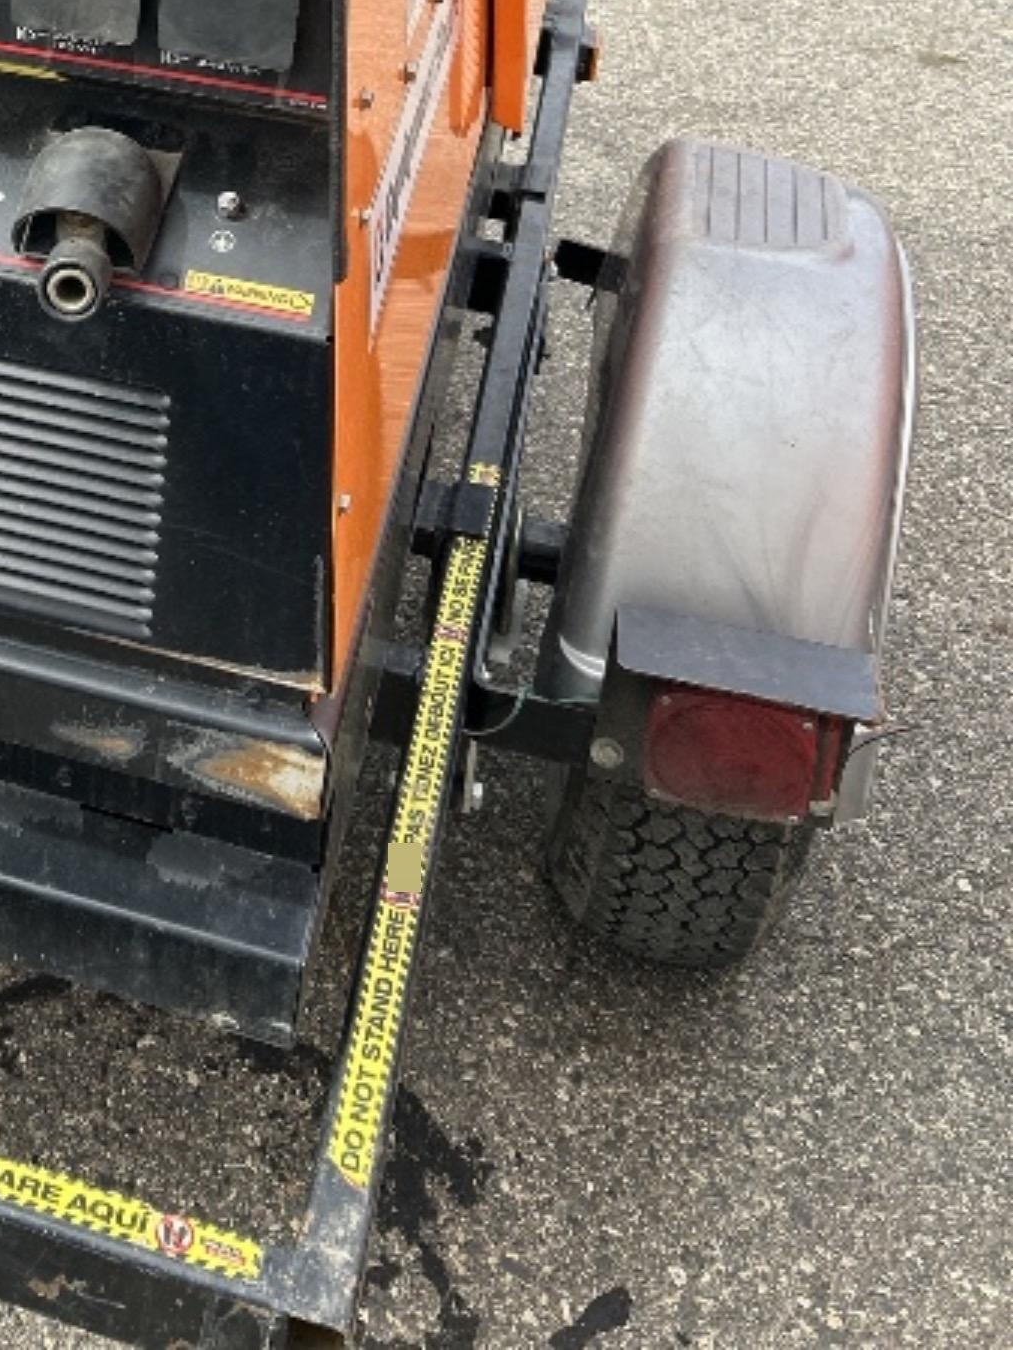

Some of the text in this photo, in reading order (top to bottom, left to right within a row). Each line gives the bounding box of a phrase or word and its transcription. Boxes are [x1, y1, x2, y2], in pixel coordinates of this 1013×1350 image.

[341, 908, 406, 1172] DO NOT STAND HERE
